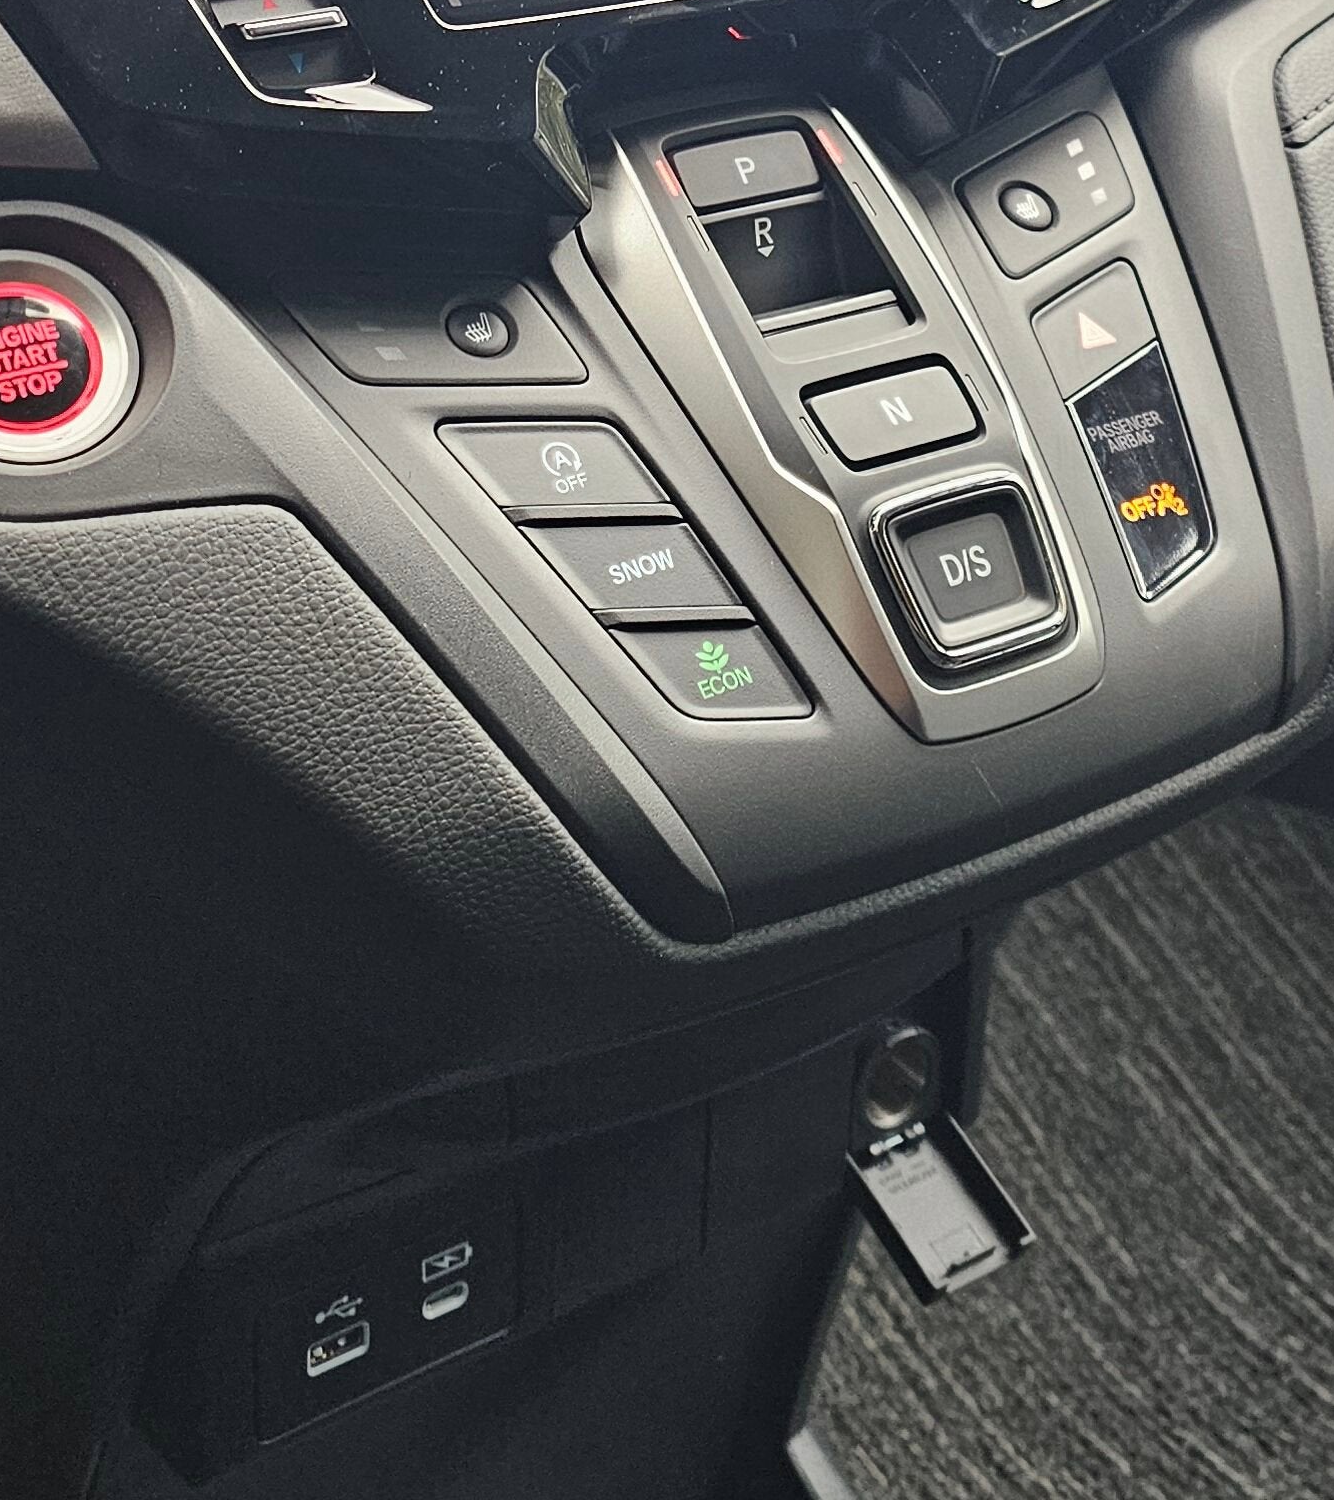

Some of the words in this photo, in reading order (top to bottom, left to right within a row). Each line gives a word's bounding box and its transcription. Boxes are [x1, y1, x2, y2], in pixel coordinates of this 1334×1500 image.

[734, 156, 756, 185] P
[754, 216, 774, 247] R
[879, 396, 914, 425] N
[1087, 410, 1164, 442] PASSENGER
[1107, 429, 1155, 454] AIRBAG
[555, 471, 588, 495] OFF
[1120, 495, 1156, 522] OFF
[608, 547, 675, 586] SNOW
[939, 544, 993, 588] D/S
[696, 665, 753, 700] ECON
